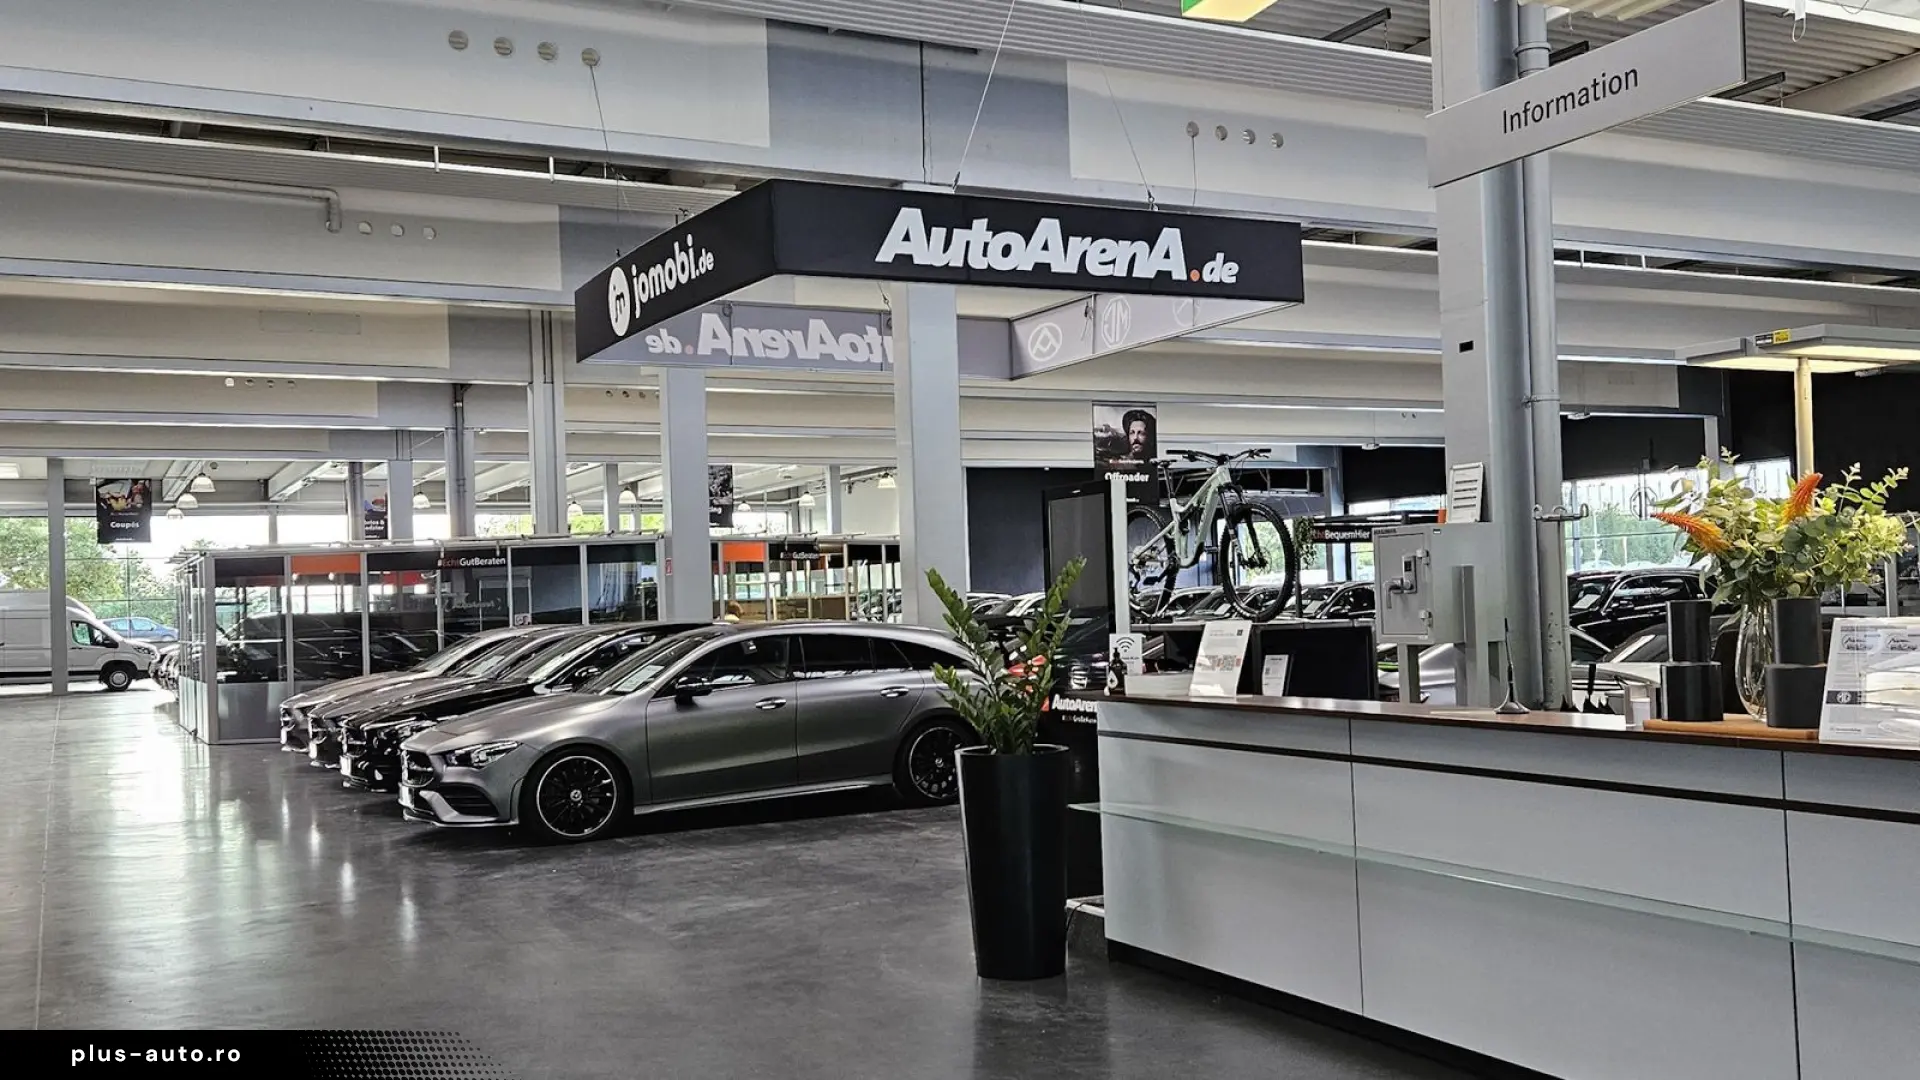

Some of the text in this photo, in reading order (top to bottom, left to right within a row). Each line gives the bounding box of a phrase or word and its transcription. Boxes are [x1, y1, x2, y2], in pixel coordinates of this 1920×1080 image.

[1502, 66, 1639, 135] Information
[631, 233, 715, 319] jomobi.de
[874, 206, 1240, 284] AutoArenA.de
[110, 521, 140, 529] Coupés
